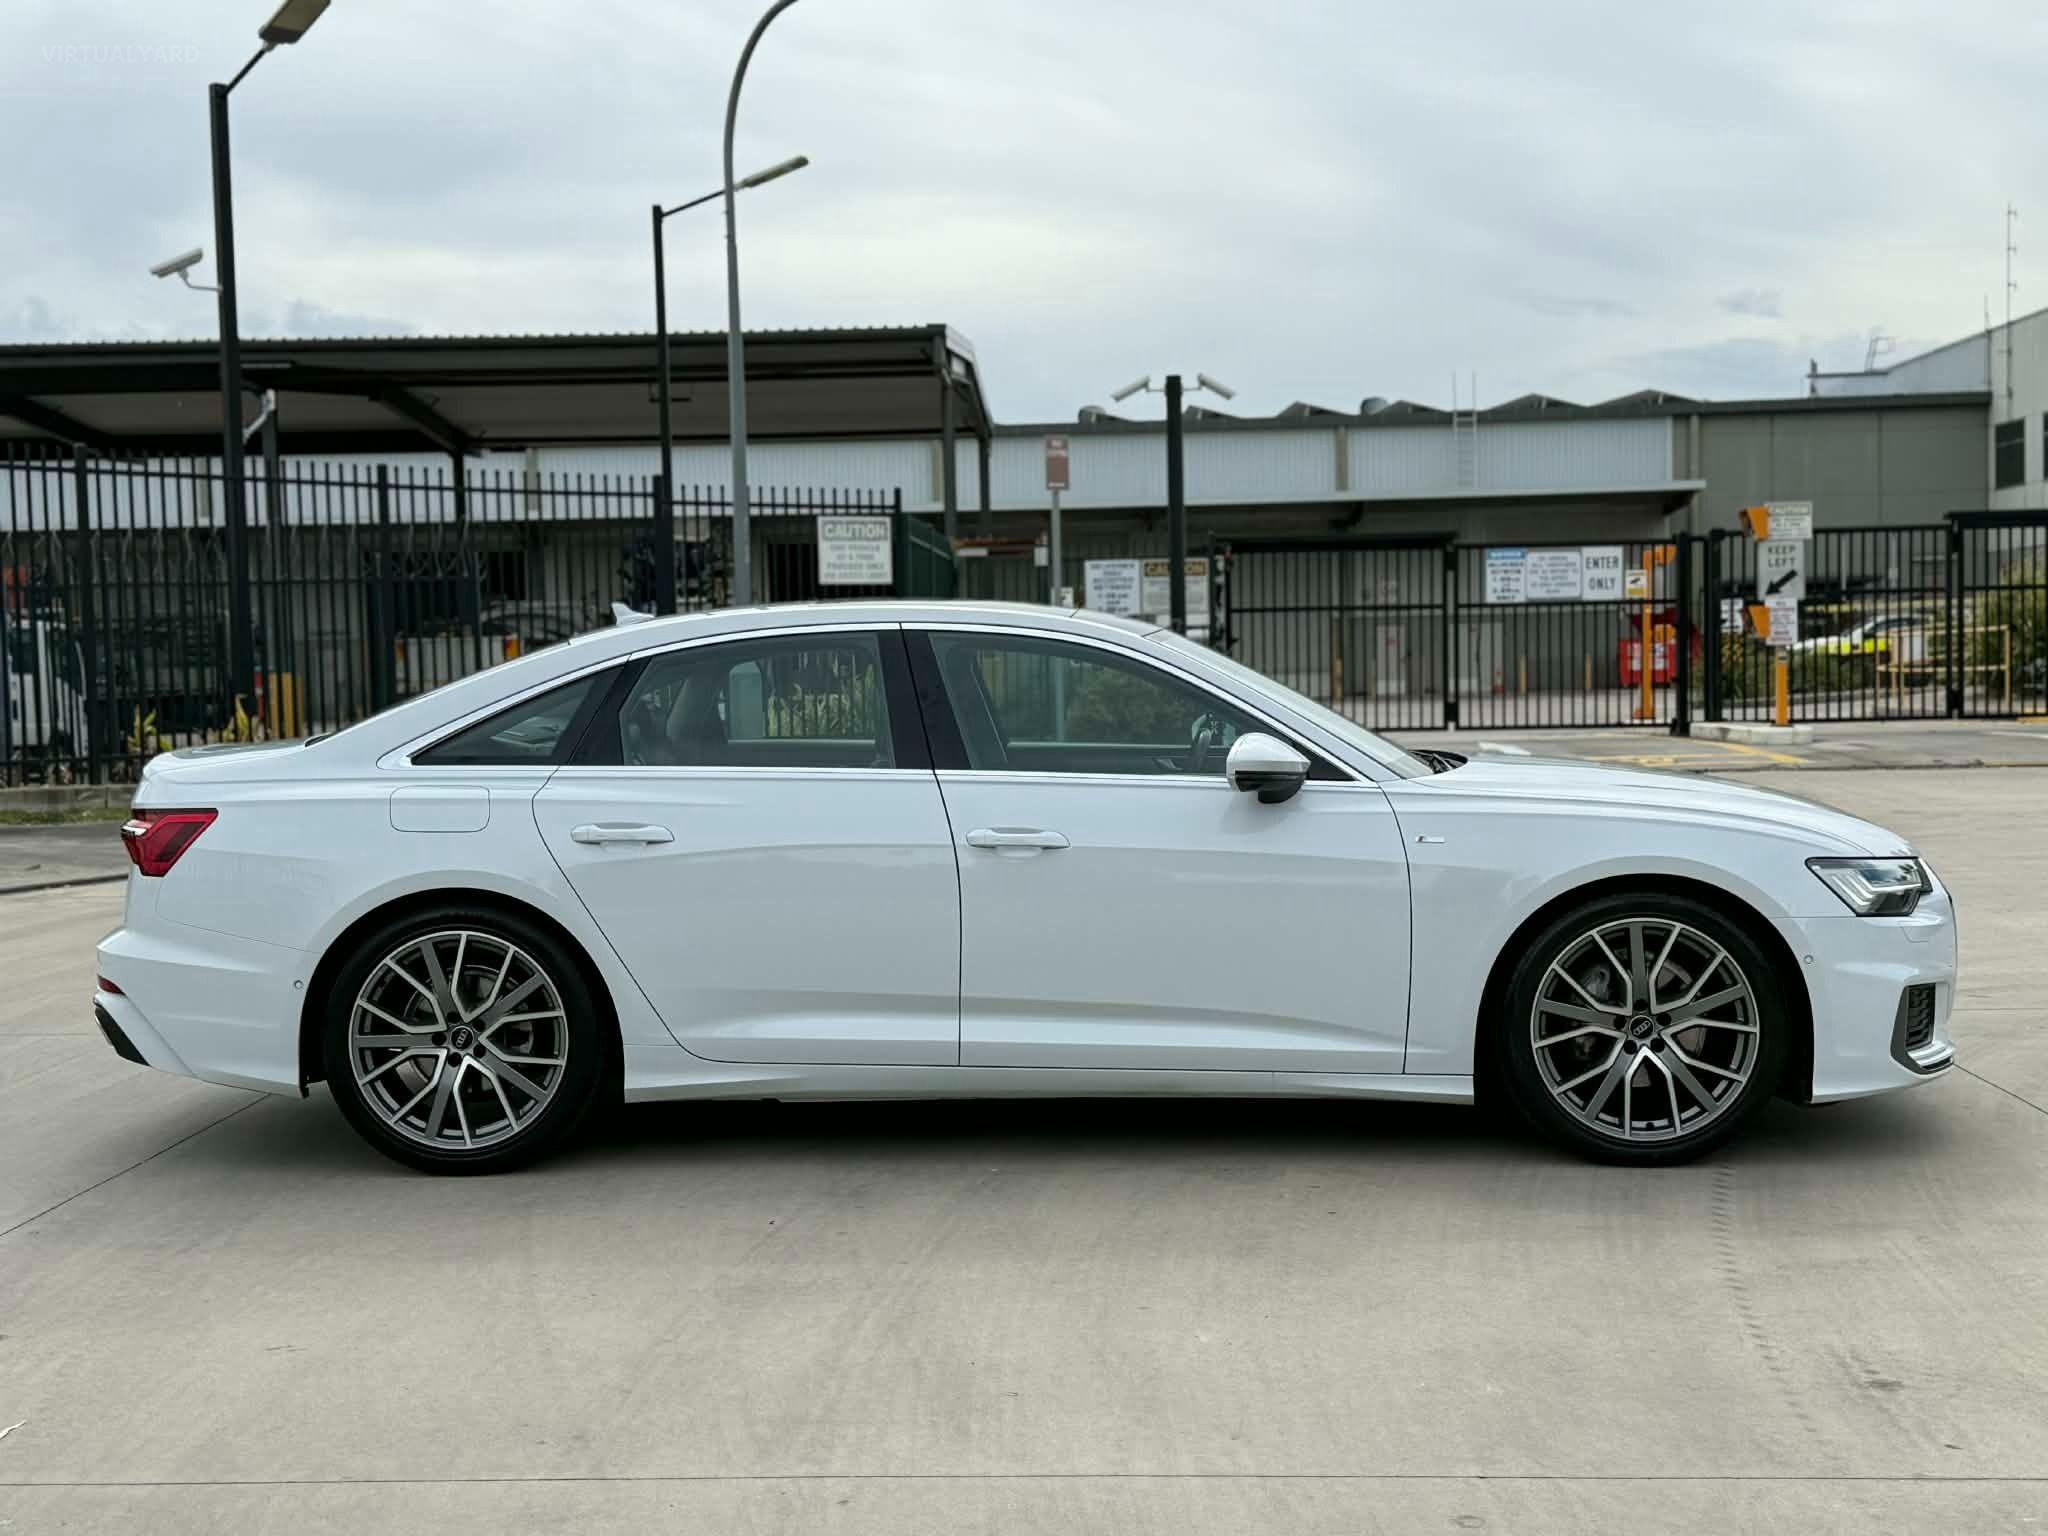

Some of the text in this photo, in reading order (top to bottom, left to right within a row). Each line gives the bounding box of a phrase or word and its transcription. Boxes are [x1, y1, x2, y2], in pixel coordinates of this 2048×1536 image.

[824, 523, 886, 538] CAUTION
[1768, 545, 1796, 555] KEEP
[1585, 556, 1620, 569] ENTER
[1768, 558, 1796, 568] LEFT
[1588, 576, 1617, 591] ONLY
